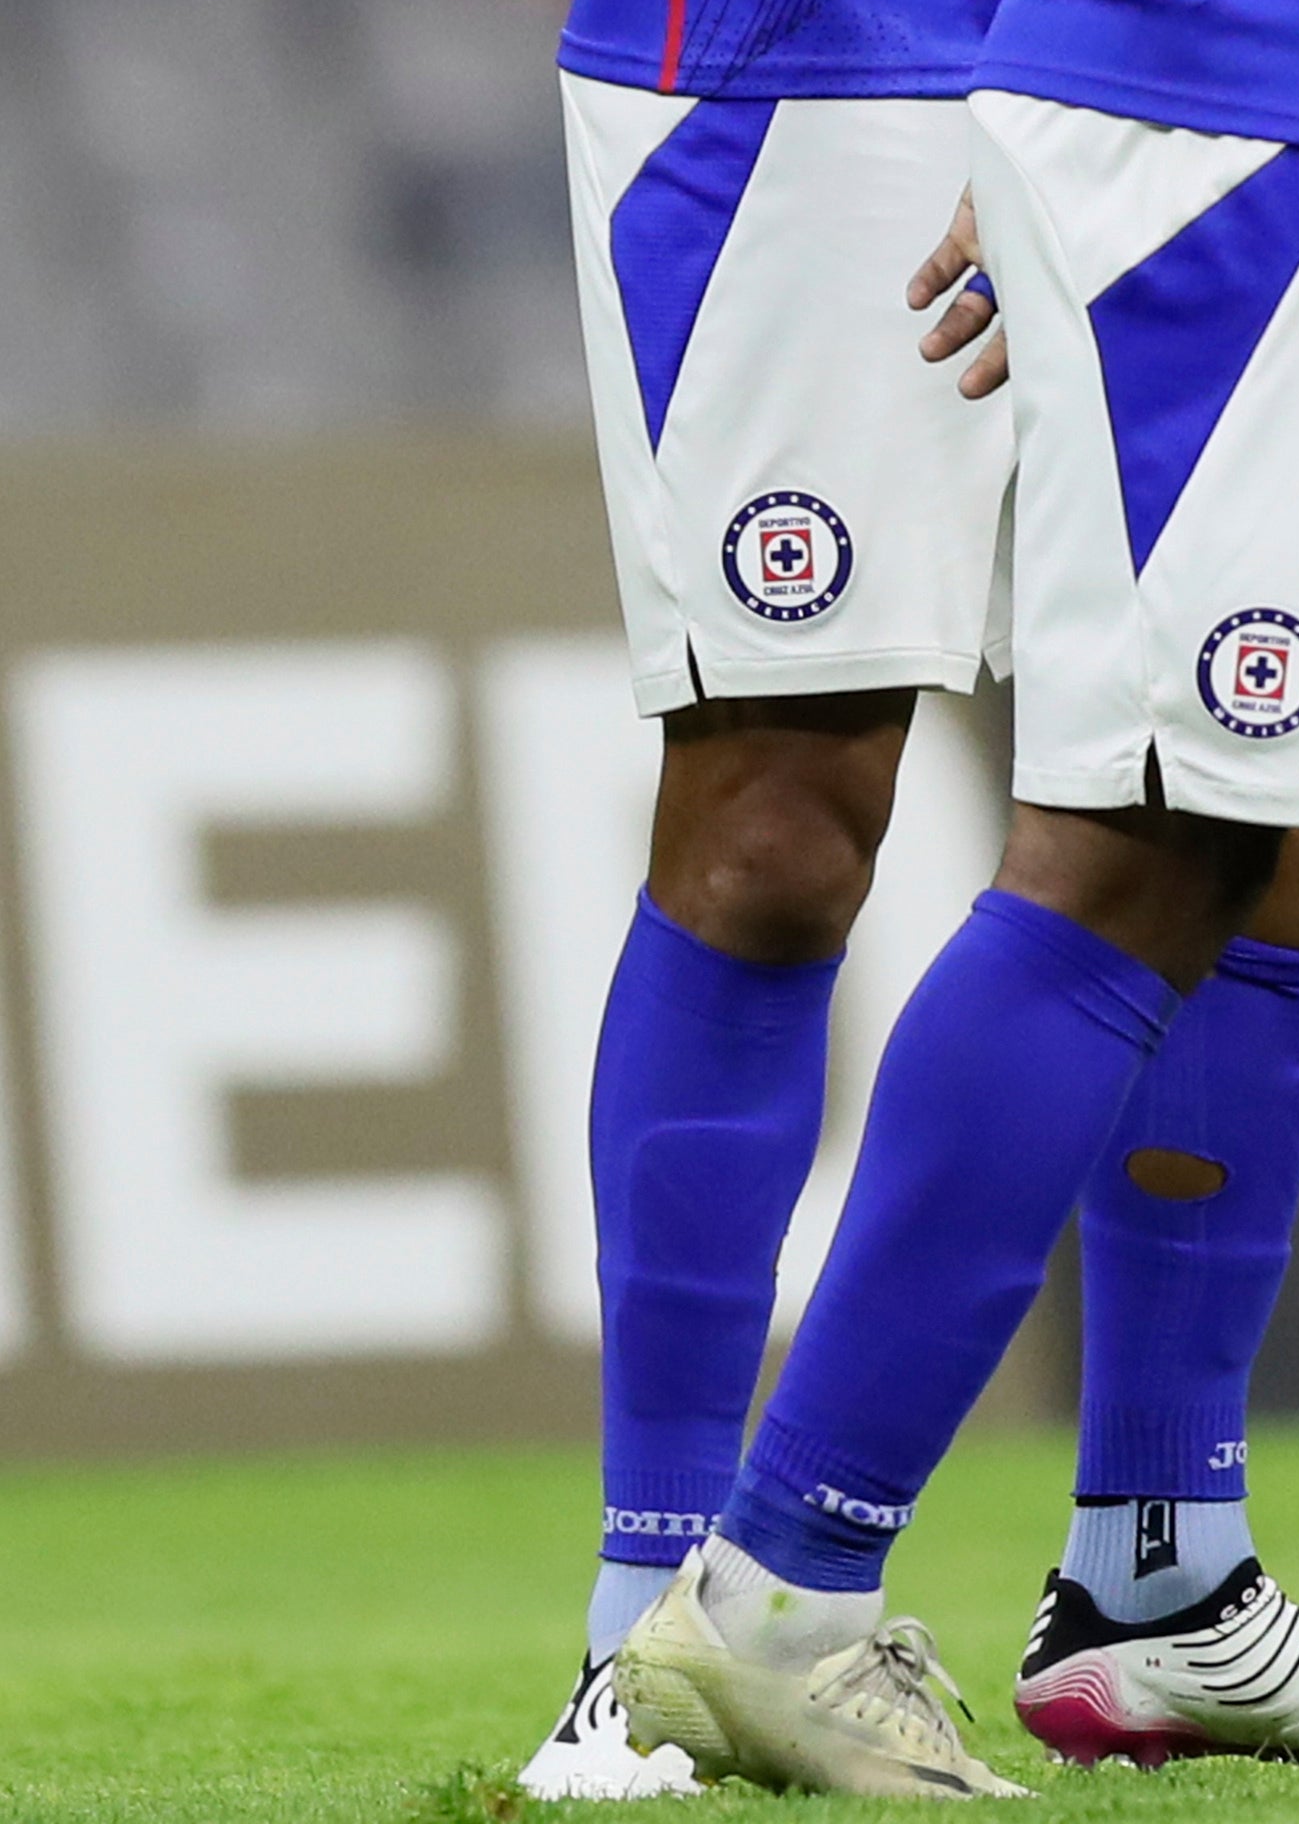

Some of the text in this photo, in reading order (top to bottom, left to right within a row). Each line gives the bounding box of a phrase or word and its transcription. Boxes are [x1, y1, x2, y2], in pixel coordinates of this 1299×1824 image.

[758, 517, 811, 528] DEPORTIVO
[763, 584, 814, 597] CRUZ AZUL
[1239, 634, 1291, 646] DEPORTIVO
[1232, 701, 1282, 714] CRUZ AZUL
